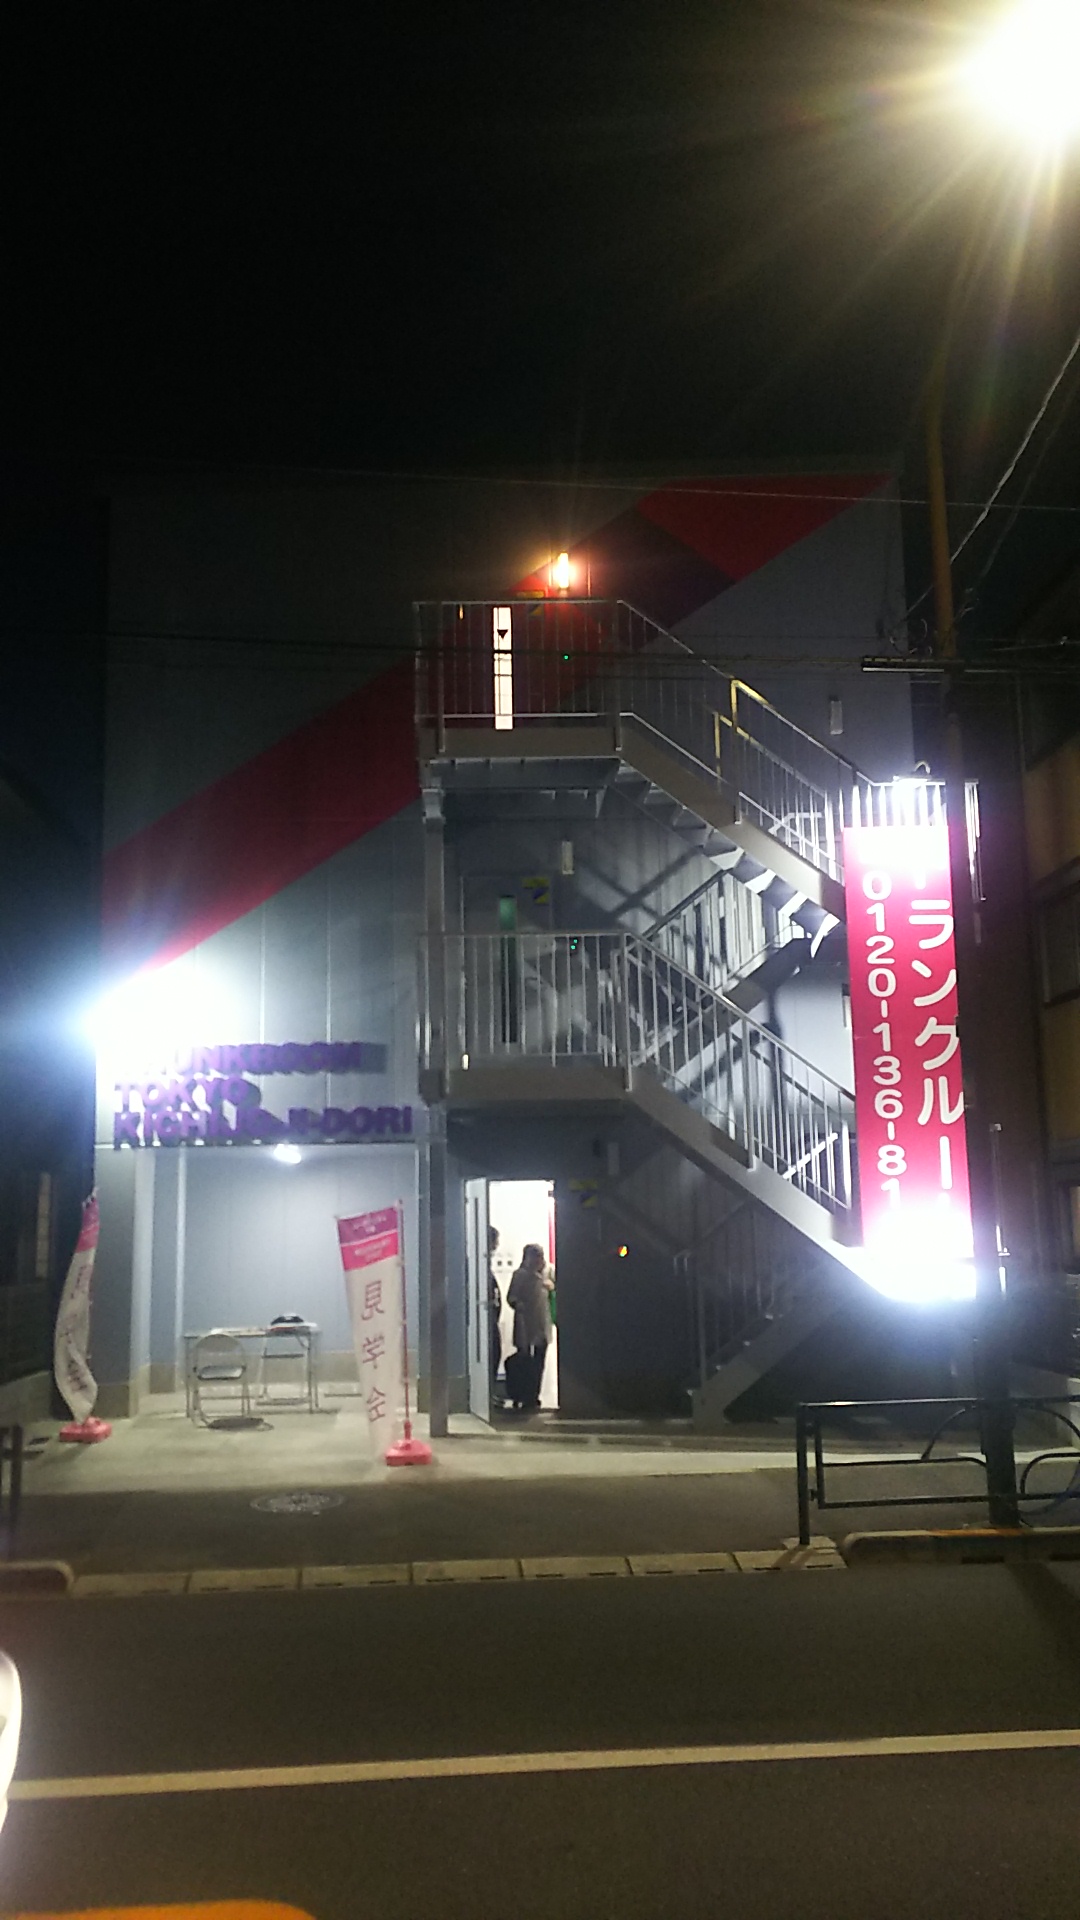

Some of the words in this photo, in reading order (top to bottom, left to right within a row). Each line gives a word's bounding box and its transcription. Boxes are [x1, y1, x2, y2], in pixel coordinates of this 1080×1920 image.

[114, 1076, 250, 1107] TOKYO
[120, 1041, 364, 1074] UNKROOM
[862, 870, 908, 1206] 0120-136-81
[908, 866, 966, 1208] ランクルー
